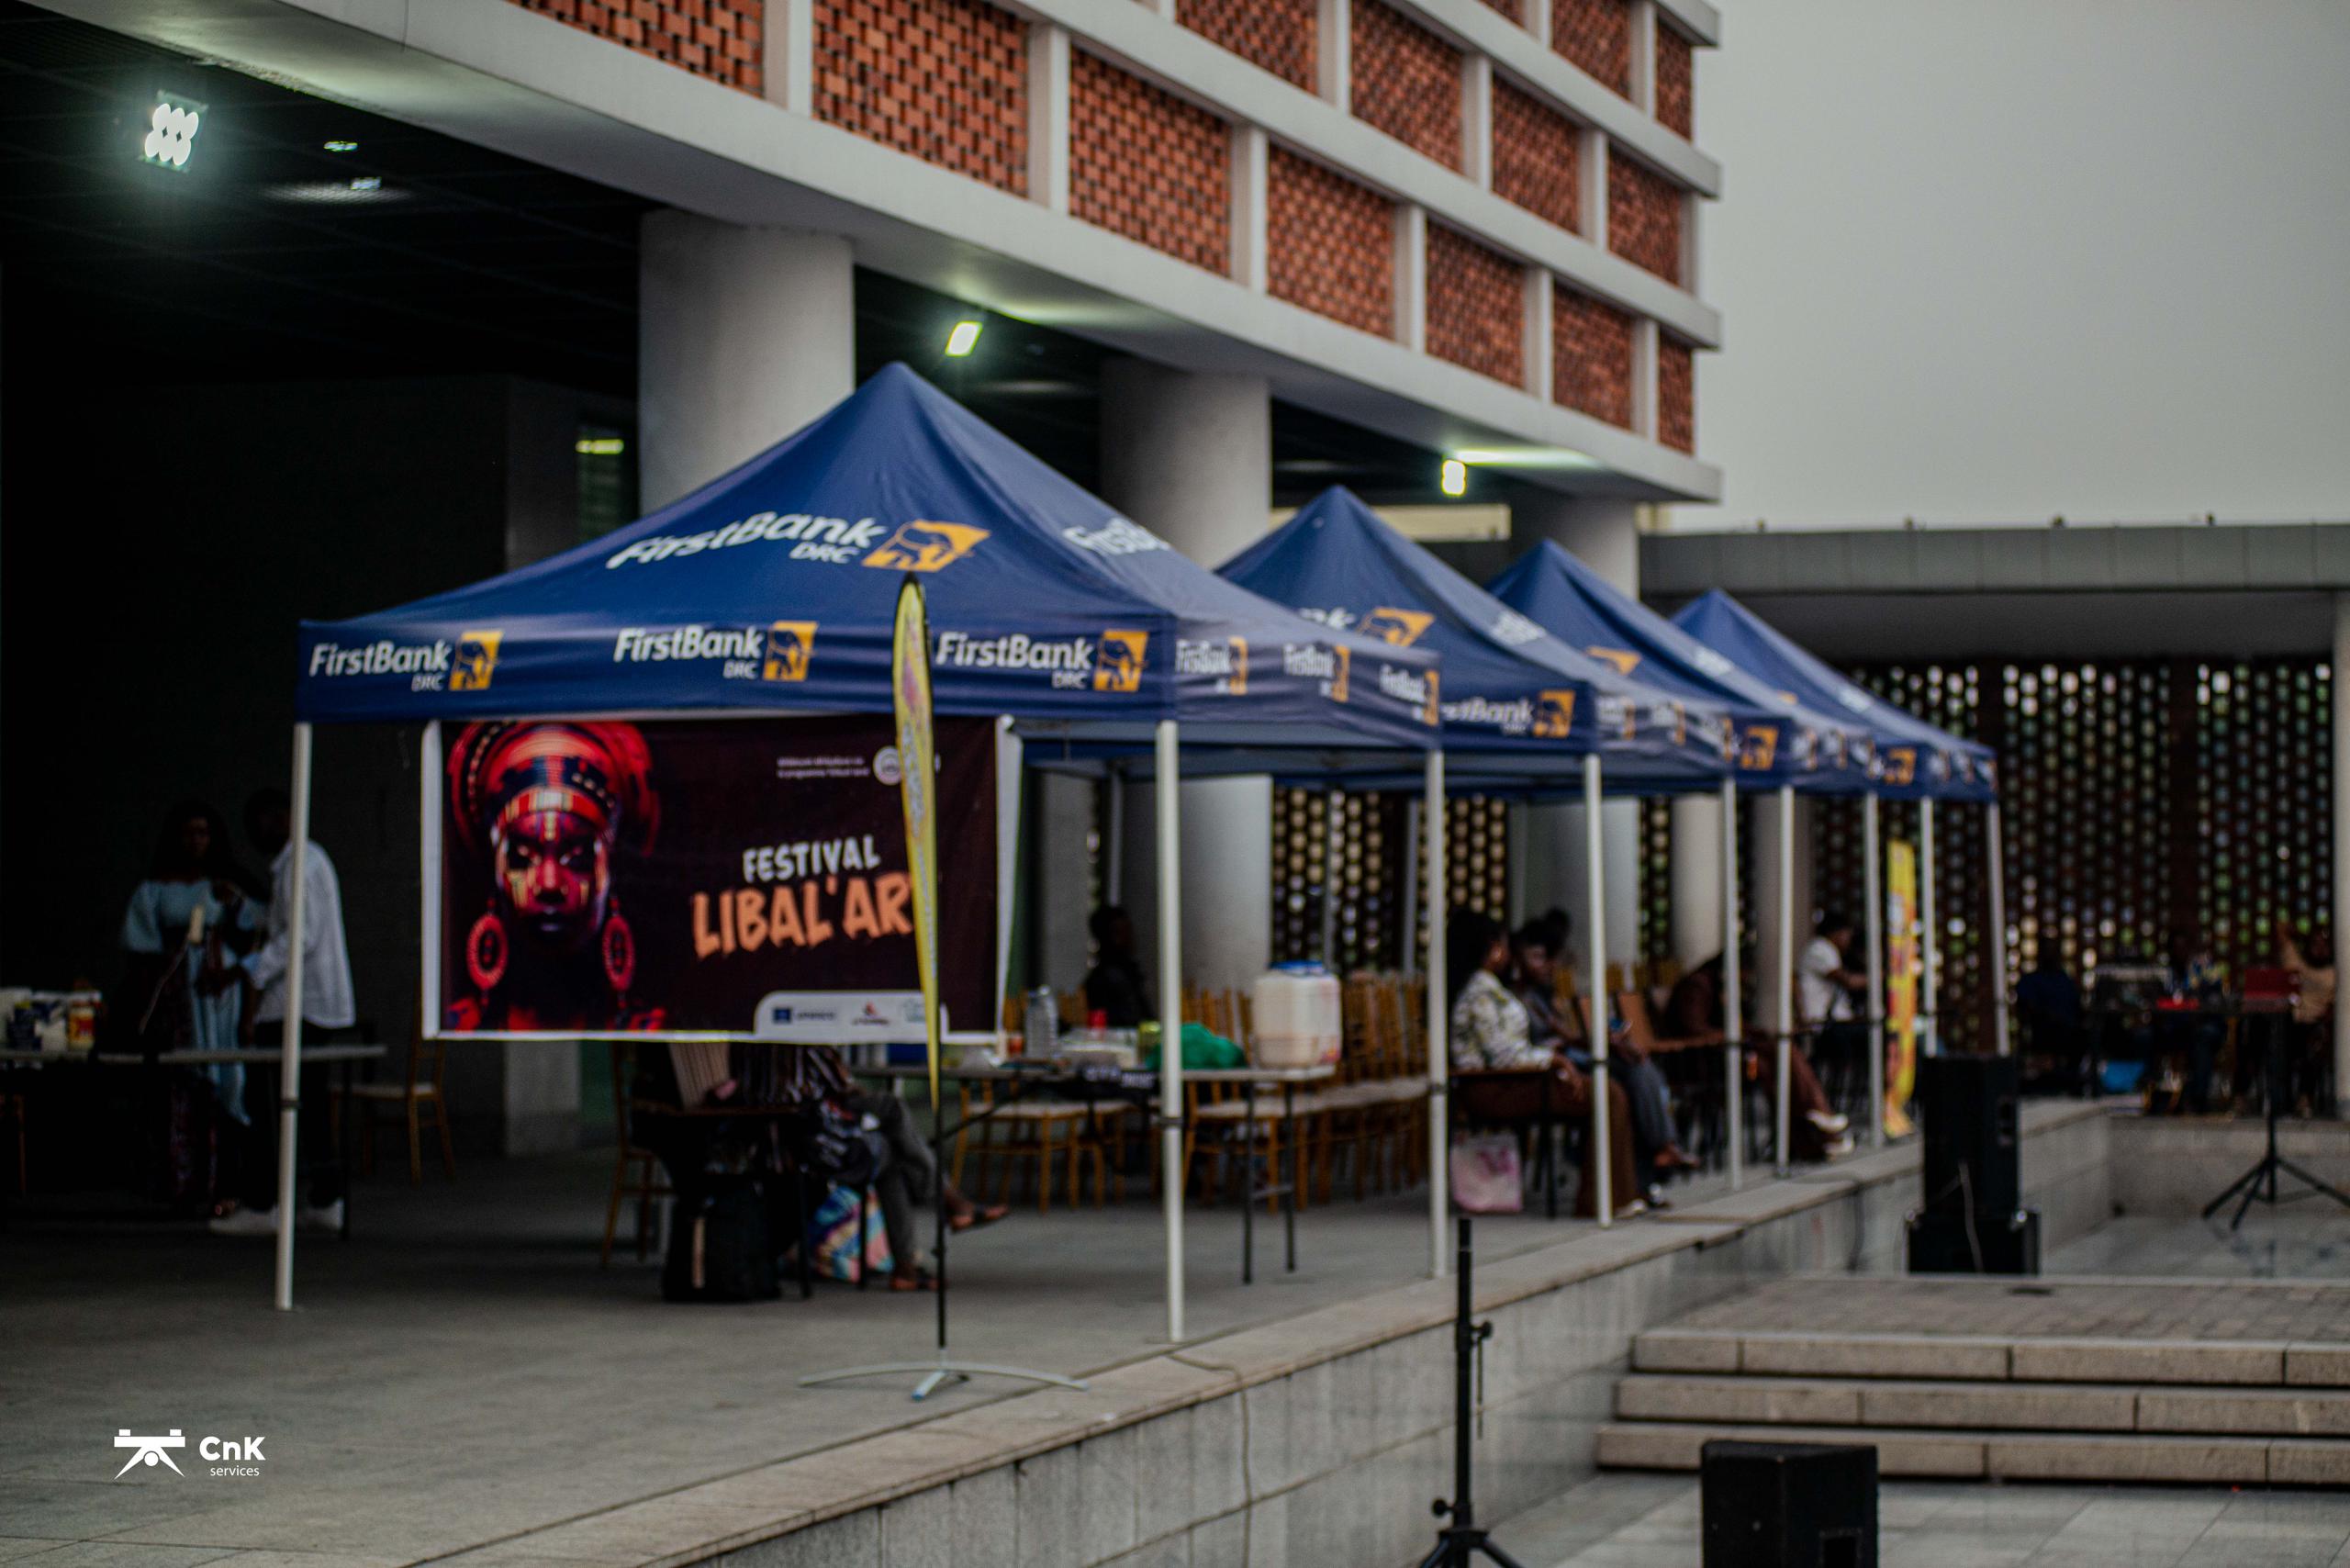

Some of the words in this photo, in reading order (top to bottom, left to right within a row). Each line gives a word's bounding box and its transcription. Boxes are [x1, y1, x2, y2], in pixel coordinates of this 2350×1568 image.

[605, 511, 888, 569] FirstBank
[789, 541, 860, 564] DRC
[308, 639, 452, 677] FirstBank
[613, 624, 764, 662] FirstBank
[934, 631, 1094, 670] FirstBank
[723, 660, 757, 679] DRC
[1051, 670, 1090, 689] DRC
[743, 834, 880, 883] FESTIVAL
[693, 870, 913, 958] LIBAL'AR
